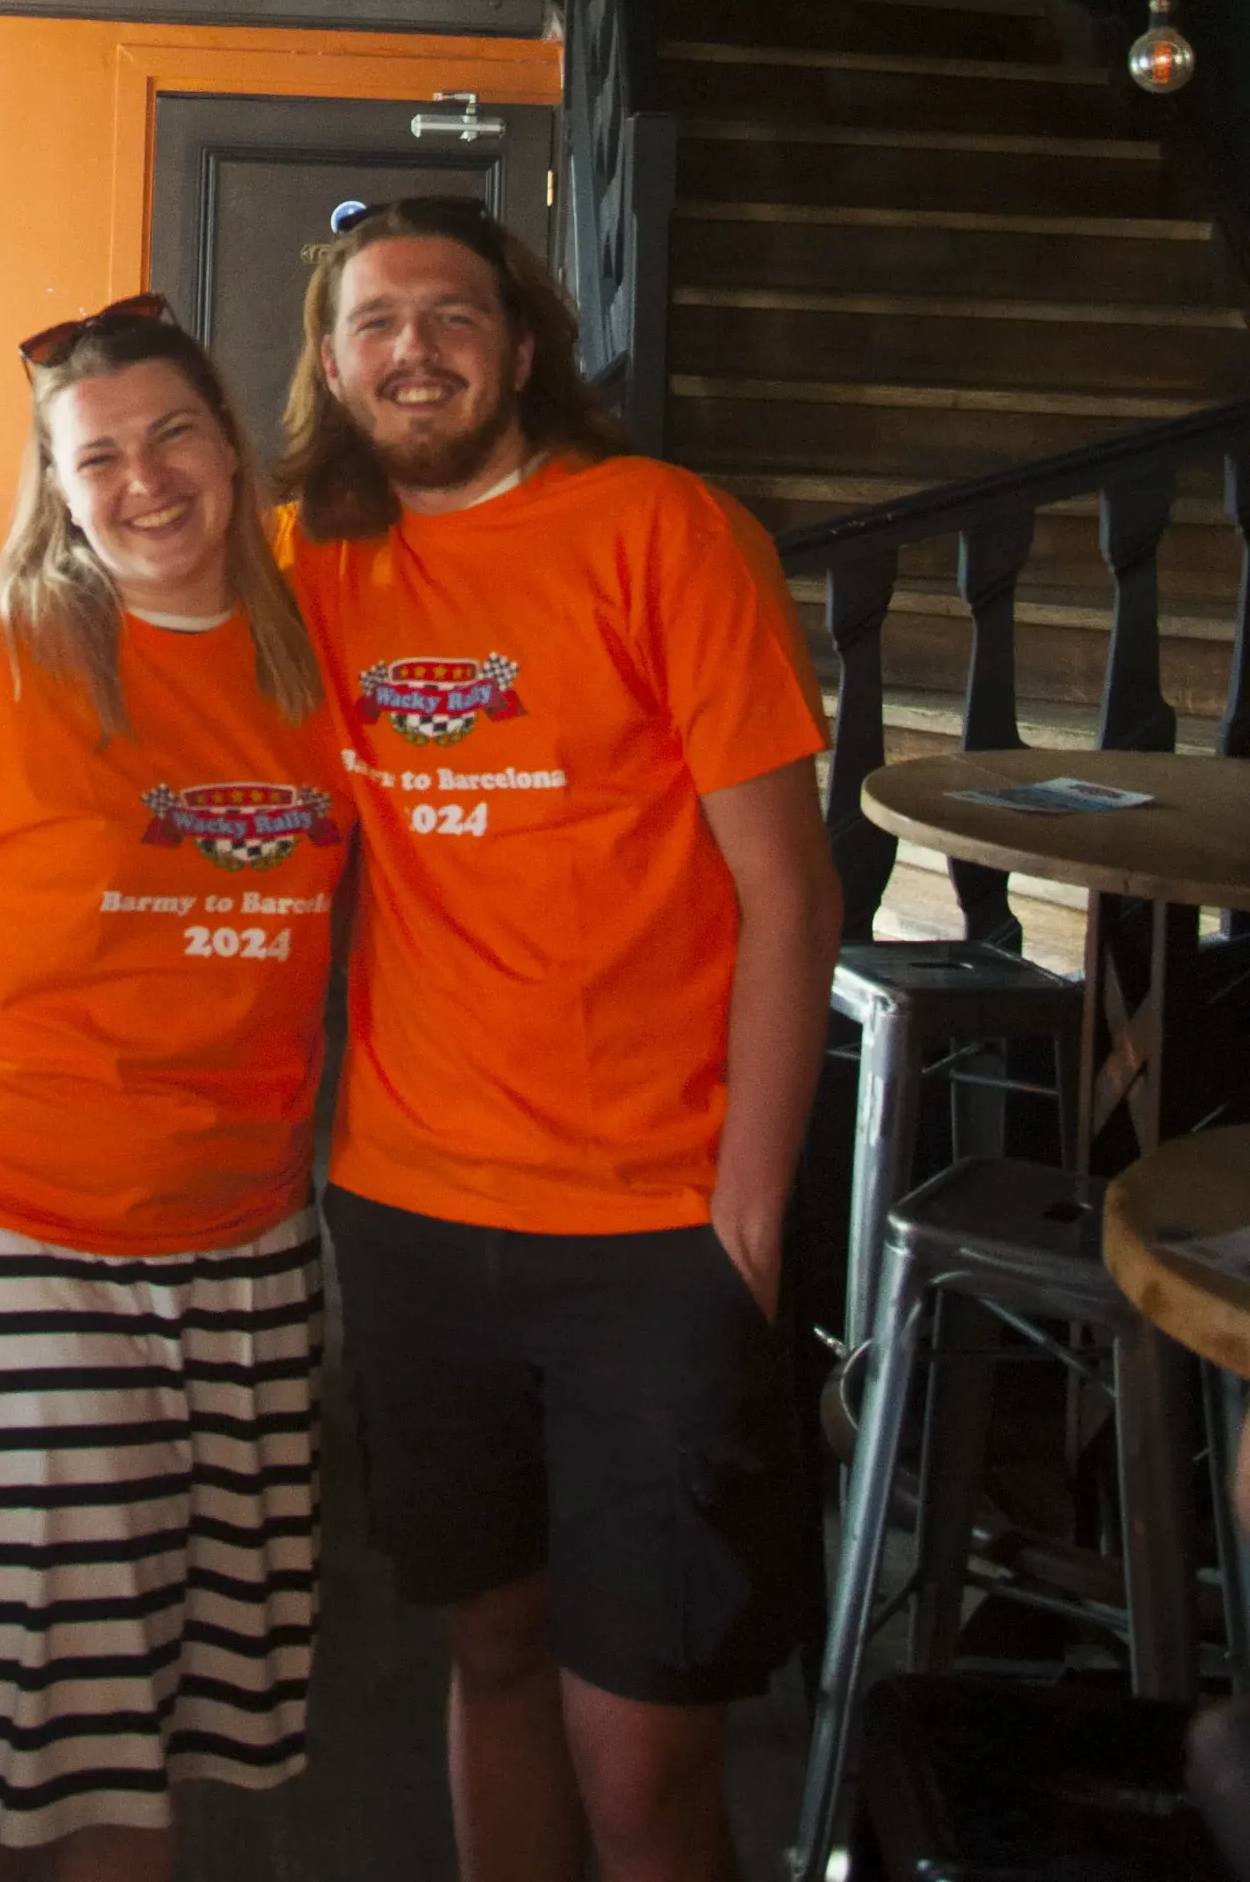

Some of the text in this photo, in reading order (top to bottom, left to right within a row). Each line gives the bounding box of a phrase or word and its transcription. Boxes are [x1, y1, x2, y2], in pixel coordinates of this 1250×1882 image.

[375, 686, 441, 714] Wacky
[401, 767, 567, 791] to Barcelona
[253, 809, 313, 834] Rally
[407, 801, 489, 837] 024
[100, 890, 198, 916] Barmy
[204, 894, 234, 912] to
[183, 925, 292, 961] 2024
